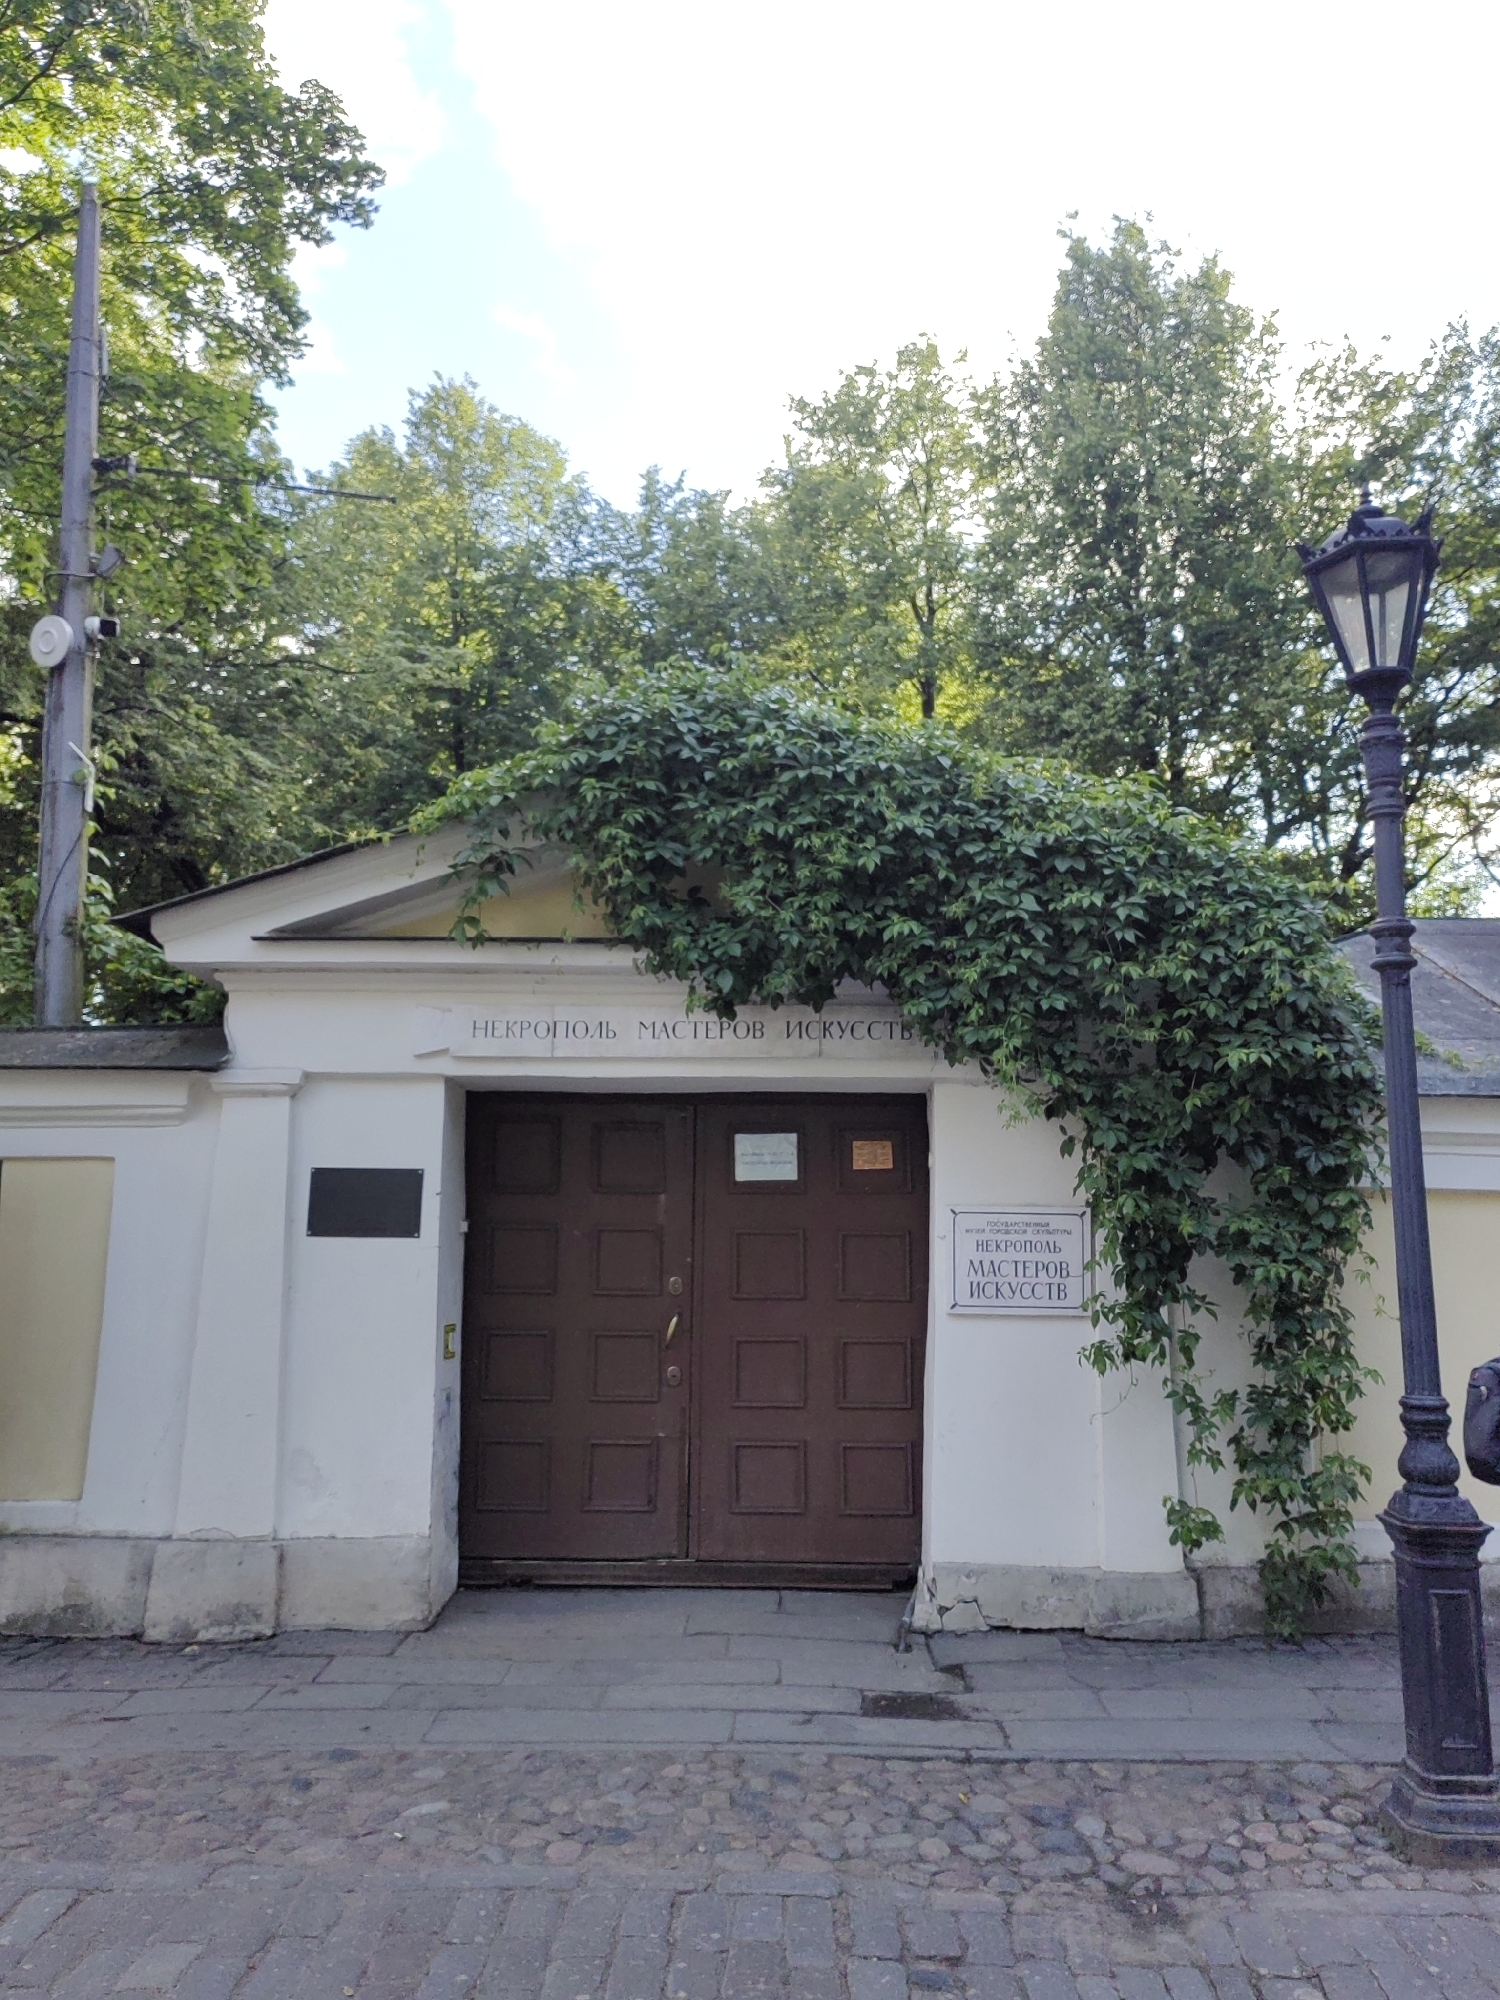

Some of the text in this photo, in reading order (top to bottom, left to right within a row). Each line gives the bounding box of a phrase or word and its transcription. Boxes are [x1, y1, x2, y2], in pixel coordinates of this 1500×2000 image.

[472, 1020, 617, 1040] НЕКРОПОЛЬ
[637, 1020, 765, 1040] МАСТЕРОВ
[975, 1240, 1062, 1253] НЕКРОПОЛЬ
[967, 1259, 1070, 1279] МАСТЕРОВ
[969, 1281, 1067, 1300] ИСКУССТВ
